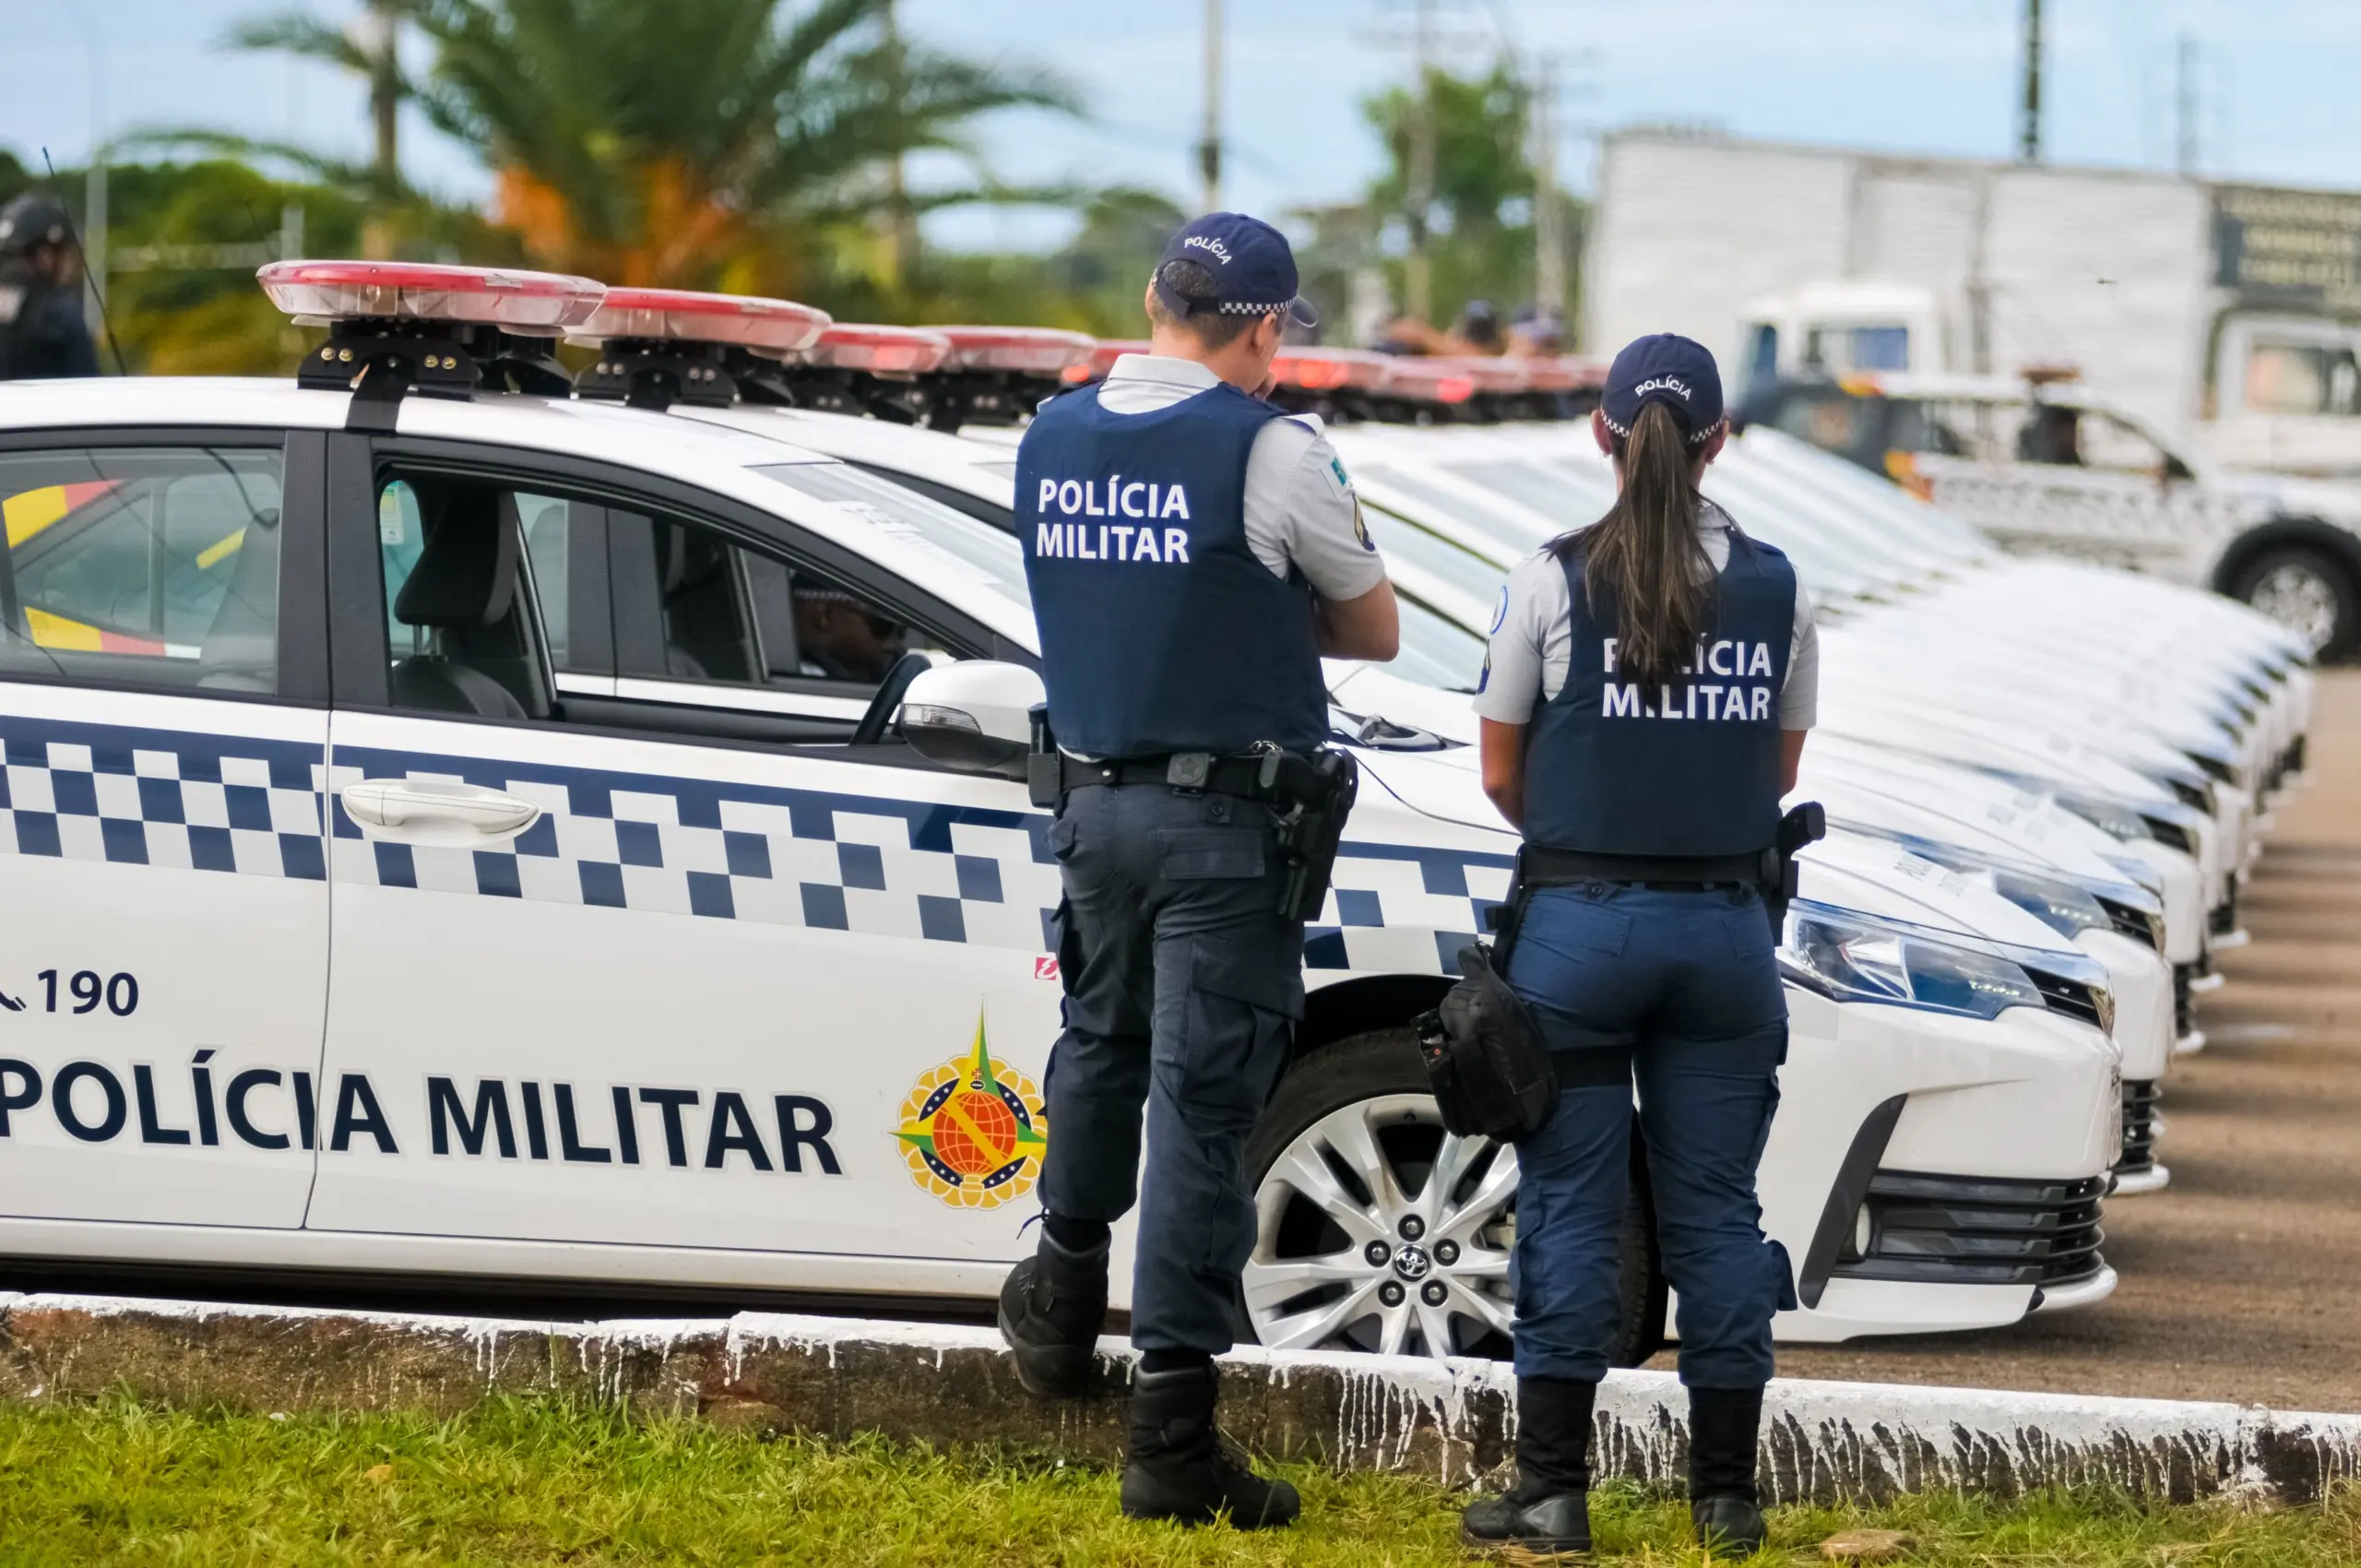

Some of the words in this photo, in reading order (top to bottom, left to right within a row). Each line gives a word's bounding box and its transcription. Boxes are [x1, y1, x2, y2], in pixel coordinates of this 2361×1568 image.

[1184, 236, 1232, 265] POLÍCIA
[1634, 374, 1692, 401] POLÍCIA
[1038, 474, 1190, 519] POLÍCIA
[1037, 522, 1190, 563] MILITAR
[1603, 632, 1773, 677] PÍCIA
[1602, 683, 1771, 720] MLITAR
[38, 969, 139, 1016] 190
[0, 1049, 399, 1154] POLÍCIA
[427, 1076, 842, 1175] MILITAR
